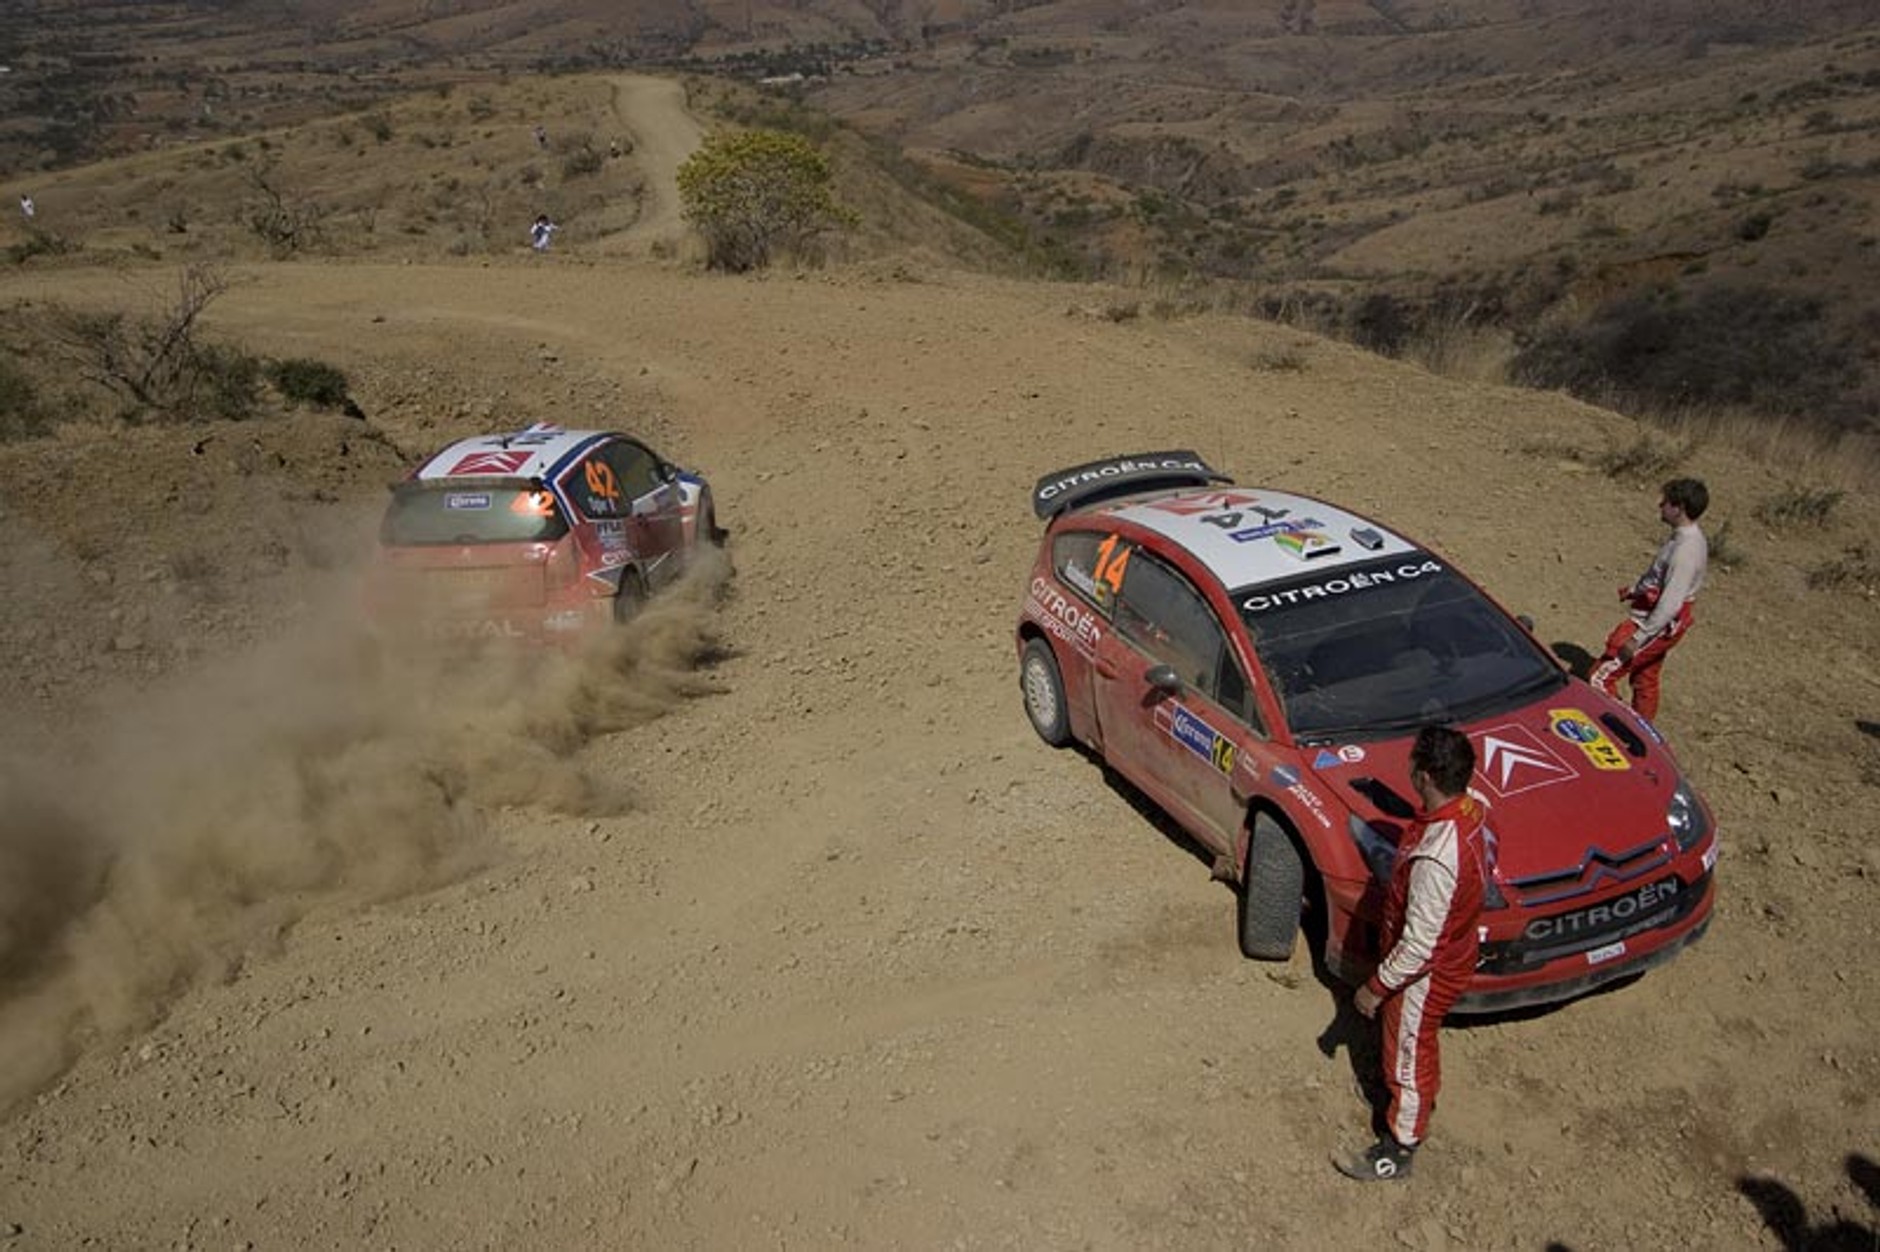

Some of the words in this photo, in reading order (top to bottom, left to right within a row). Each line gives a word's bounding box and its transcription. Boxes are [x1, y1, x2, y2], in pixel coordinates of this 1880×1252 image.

[584, 460, 620, 499] 42
[1039, 461, 1157, 499] CITROËN
[1161, 460, 1204, 471] C4
[509, 490, 555, 516] 42
[1094, 534, 1131, 593] 14
[1243, 572, 1395, 610] CITROËN
[1397, 560, 1442, 577] C4
[1031, 577, 1101, 645] CITROËN
[1215, 738, 1234, 775] 14
[1525, 878, 1678, 940] CITROËN
